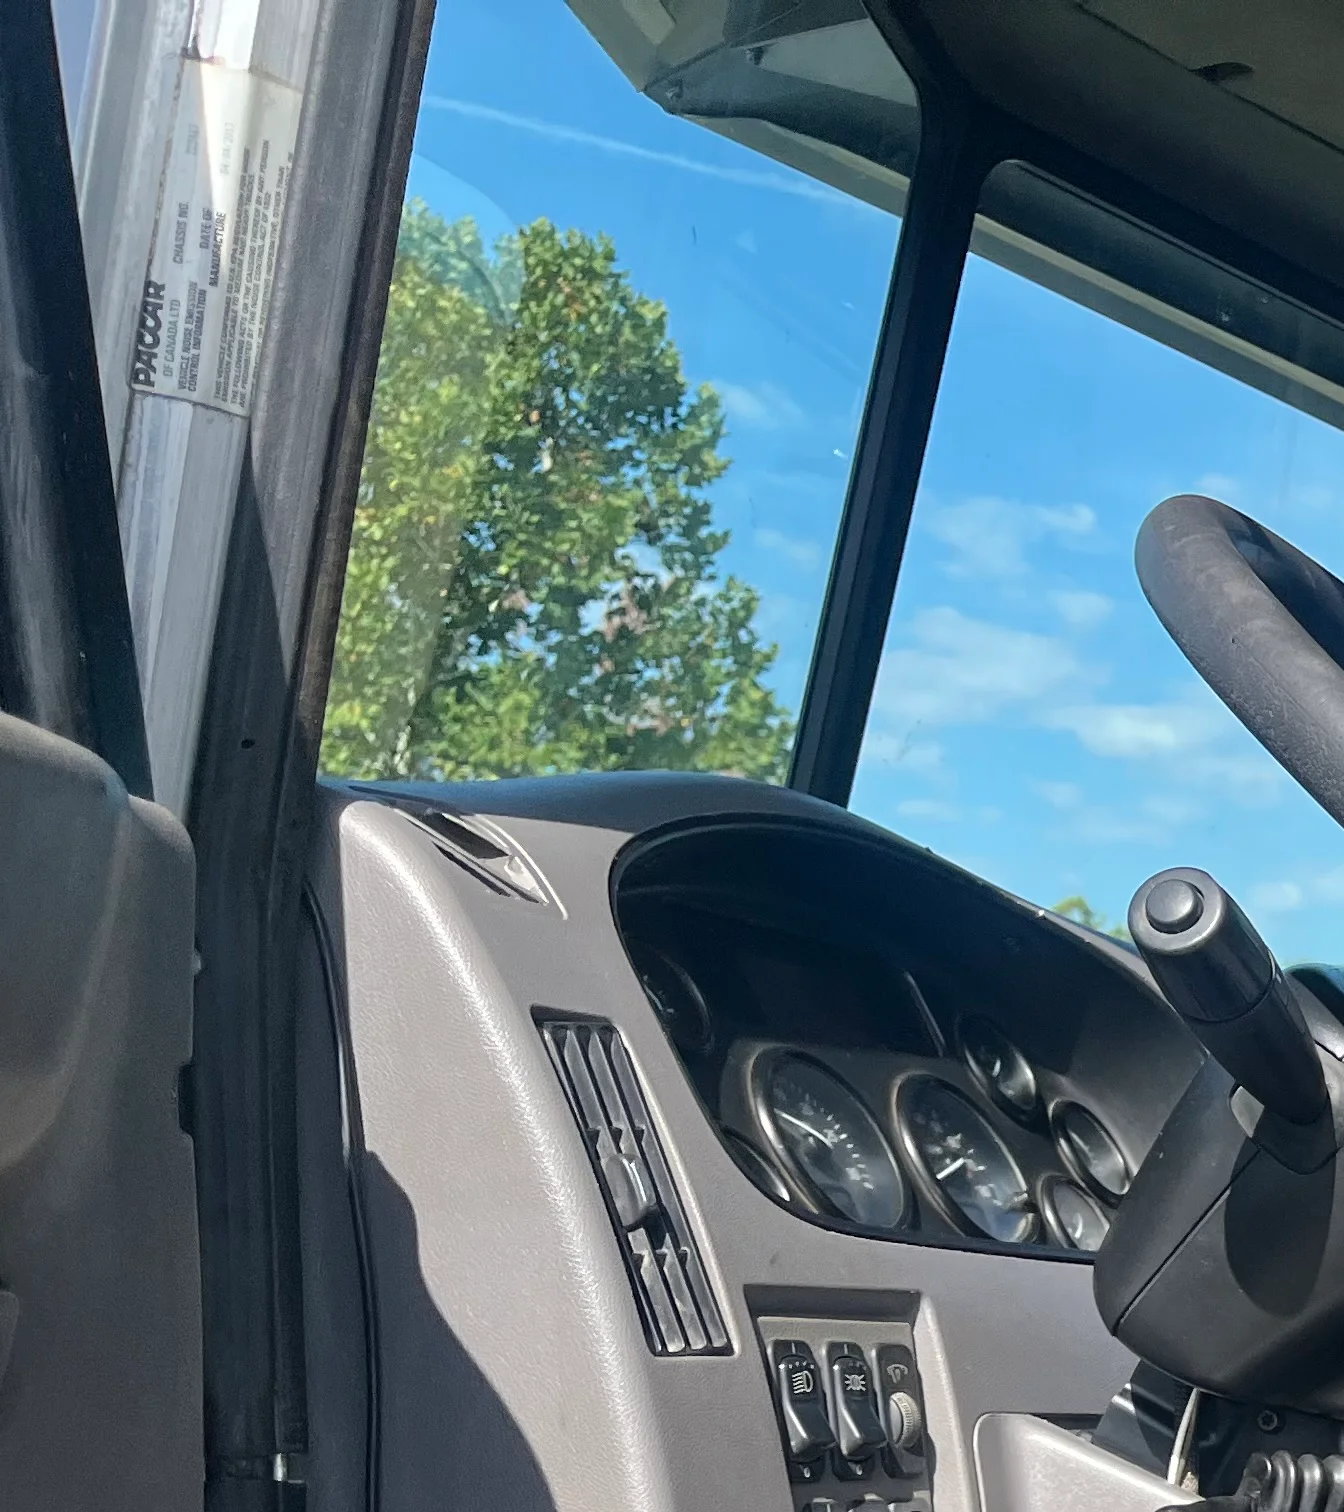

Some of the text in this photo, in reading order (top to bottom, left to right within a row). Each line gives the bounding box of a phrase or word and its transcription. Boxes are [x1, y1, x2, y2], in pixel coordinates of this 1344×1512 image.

[173, 219, 186, 264] CHASSIS
[200, 207, 212, 249] DATE OF
[209, 211, 225, 287] MANUFACTURE
[133, 279, 165, 388] PACCAR
[163, 299, 180, 377] OF CANADA LTD
[179, 280, 197, 390] VEHICLE NOISE EMISSION
[189, 289, 206, 392] CONTROL INFORMATION
